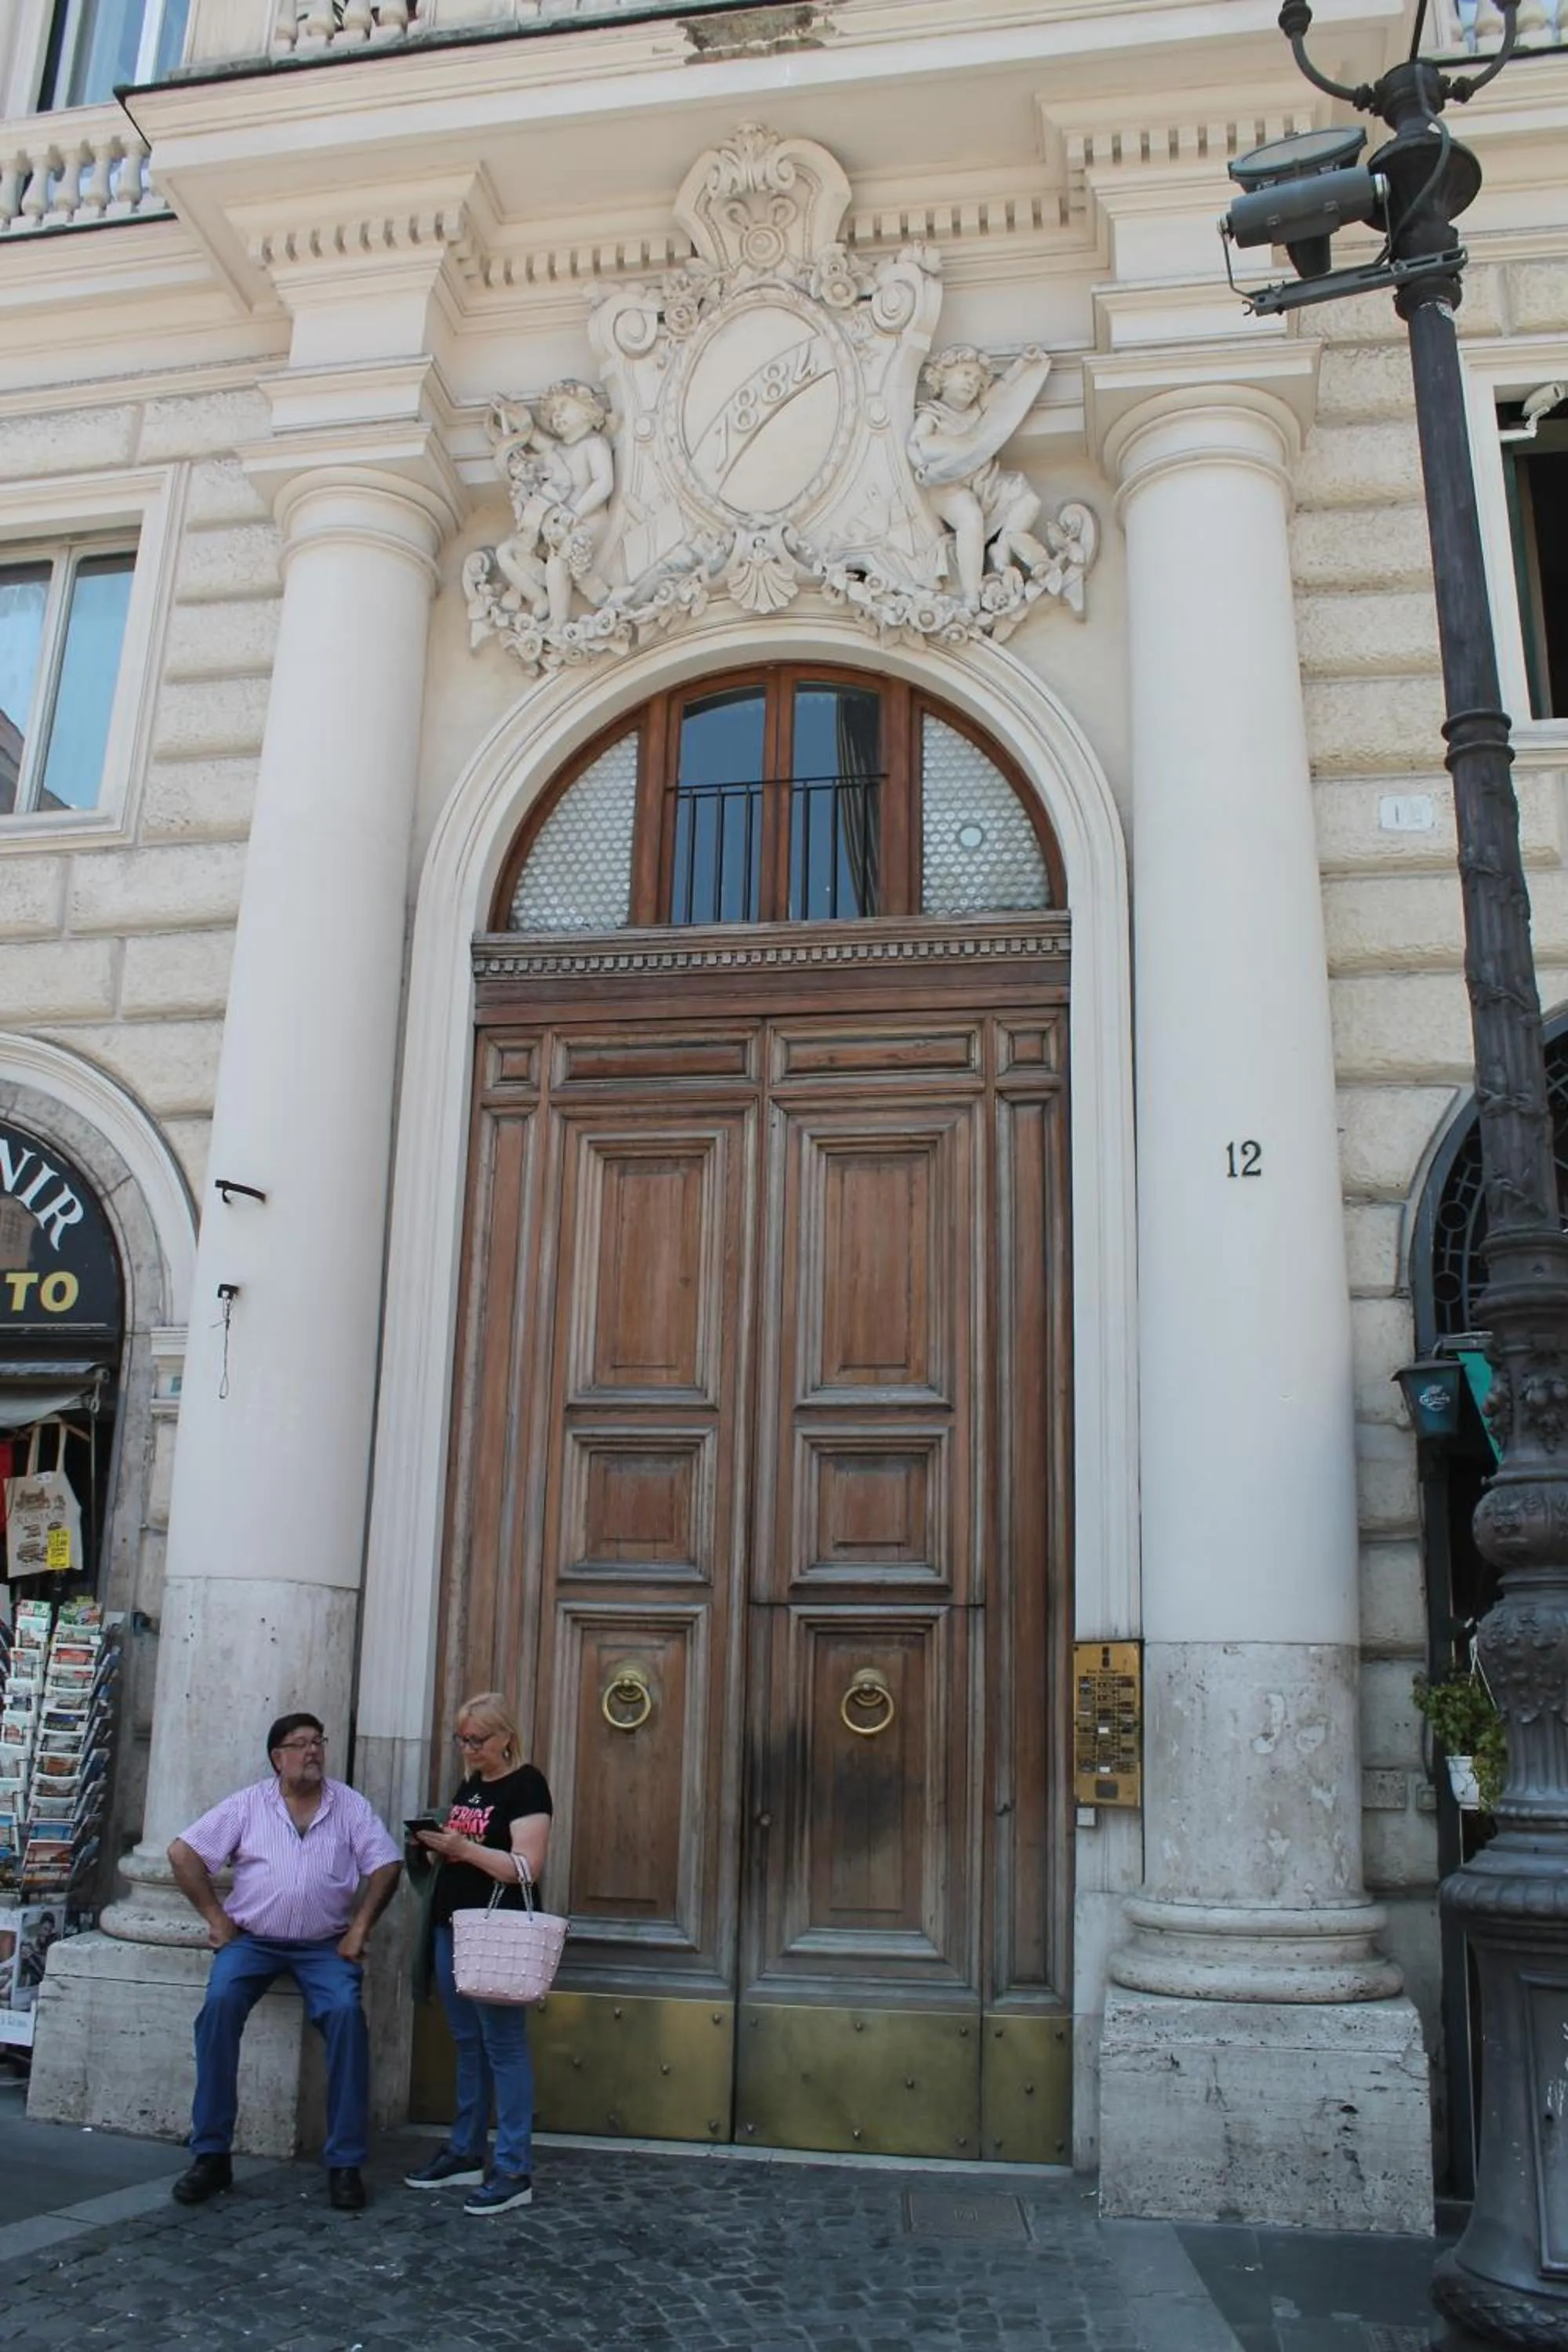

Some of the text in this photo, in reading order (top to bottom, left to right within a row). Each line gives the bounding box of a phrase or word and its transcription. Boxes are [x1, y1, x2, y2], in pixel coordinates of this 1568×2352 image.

[714, 339, 818, 474] 1884
[1226, 1139, 1261, 1178] 12
[5, 1271, 78, 1312] TO
